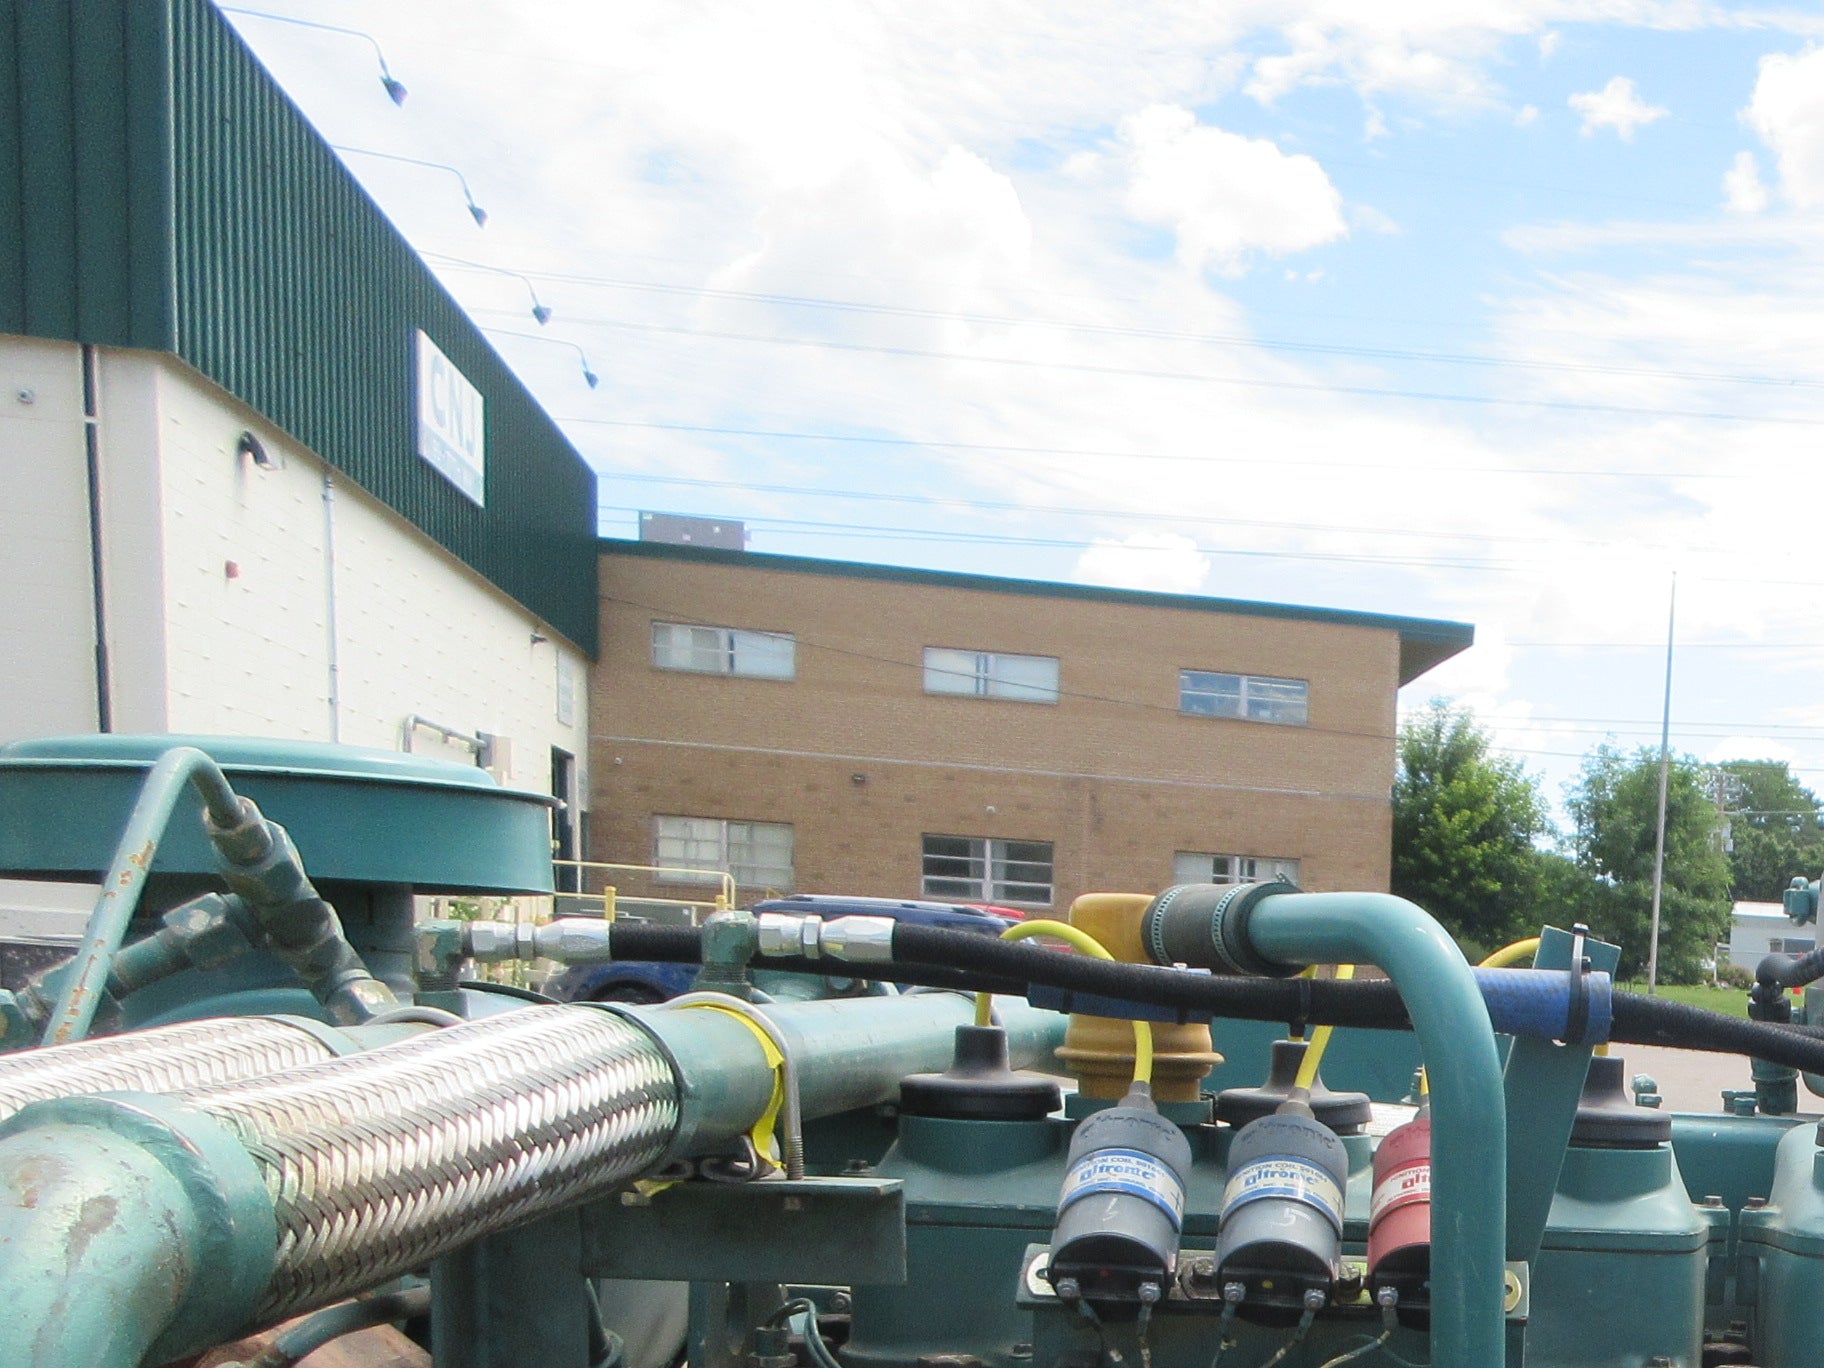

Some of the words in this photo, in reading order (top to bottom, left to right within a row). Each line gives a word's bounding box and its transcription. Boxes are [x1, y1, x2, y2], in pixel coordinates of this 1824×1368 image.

[1079, 1164, 1157, 1182] altronic
[1275, 1162, 1298, 1170] COIL
[1244, 1168, 1316, 1188] altronic
